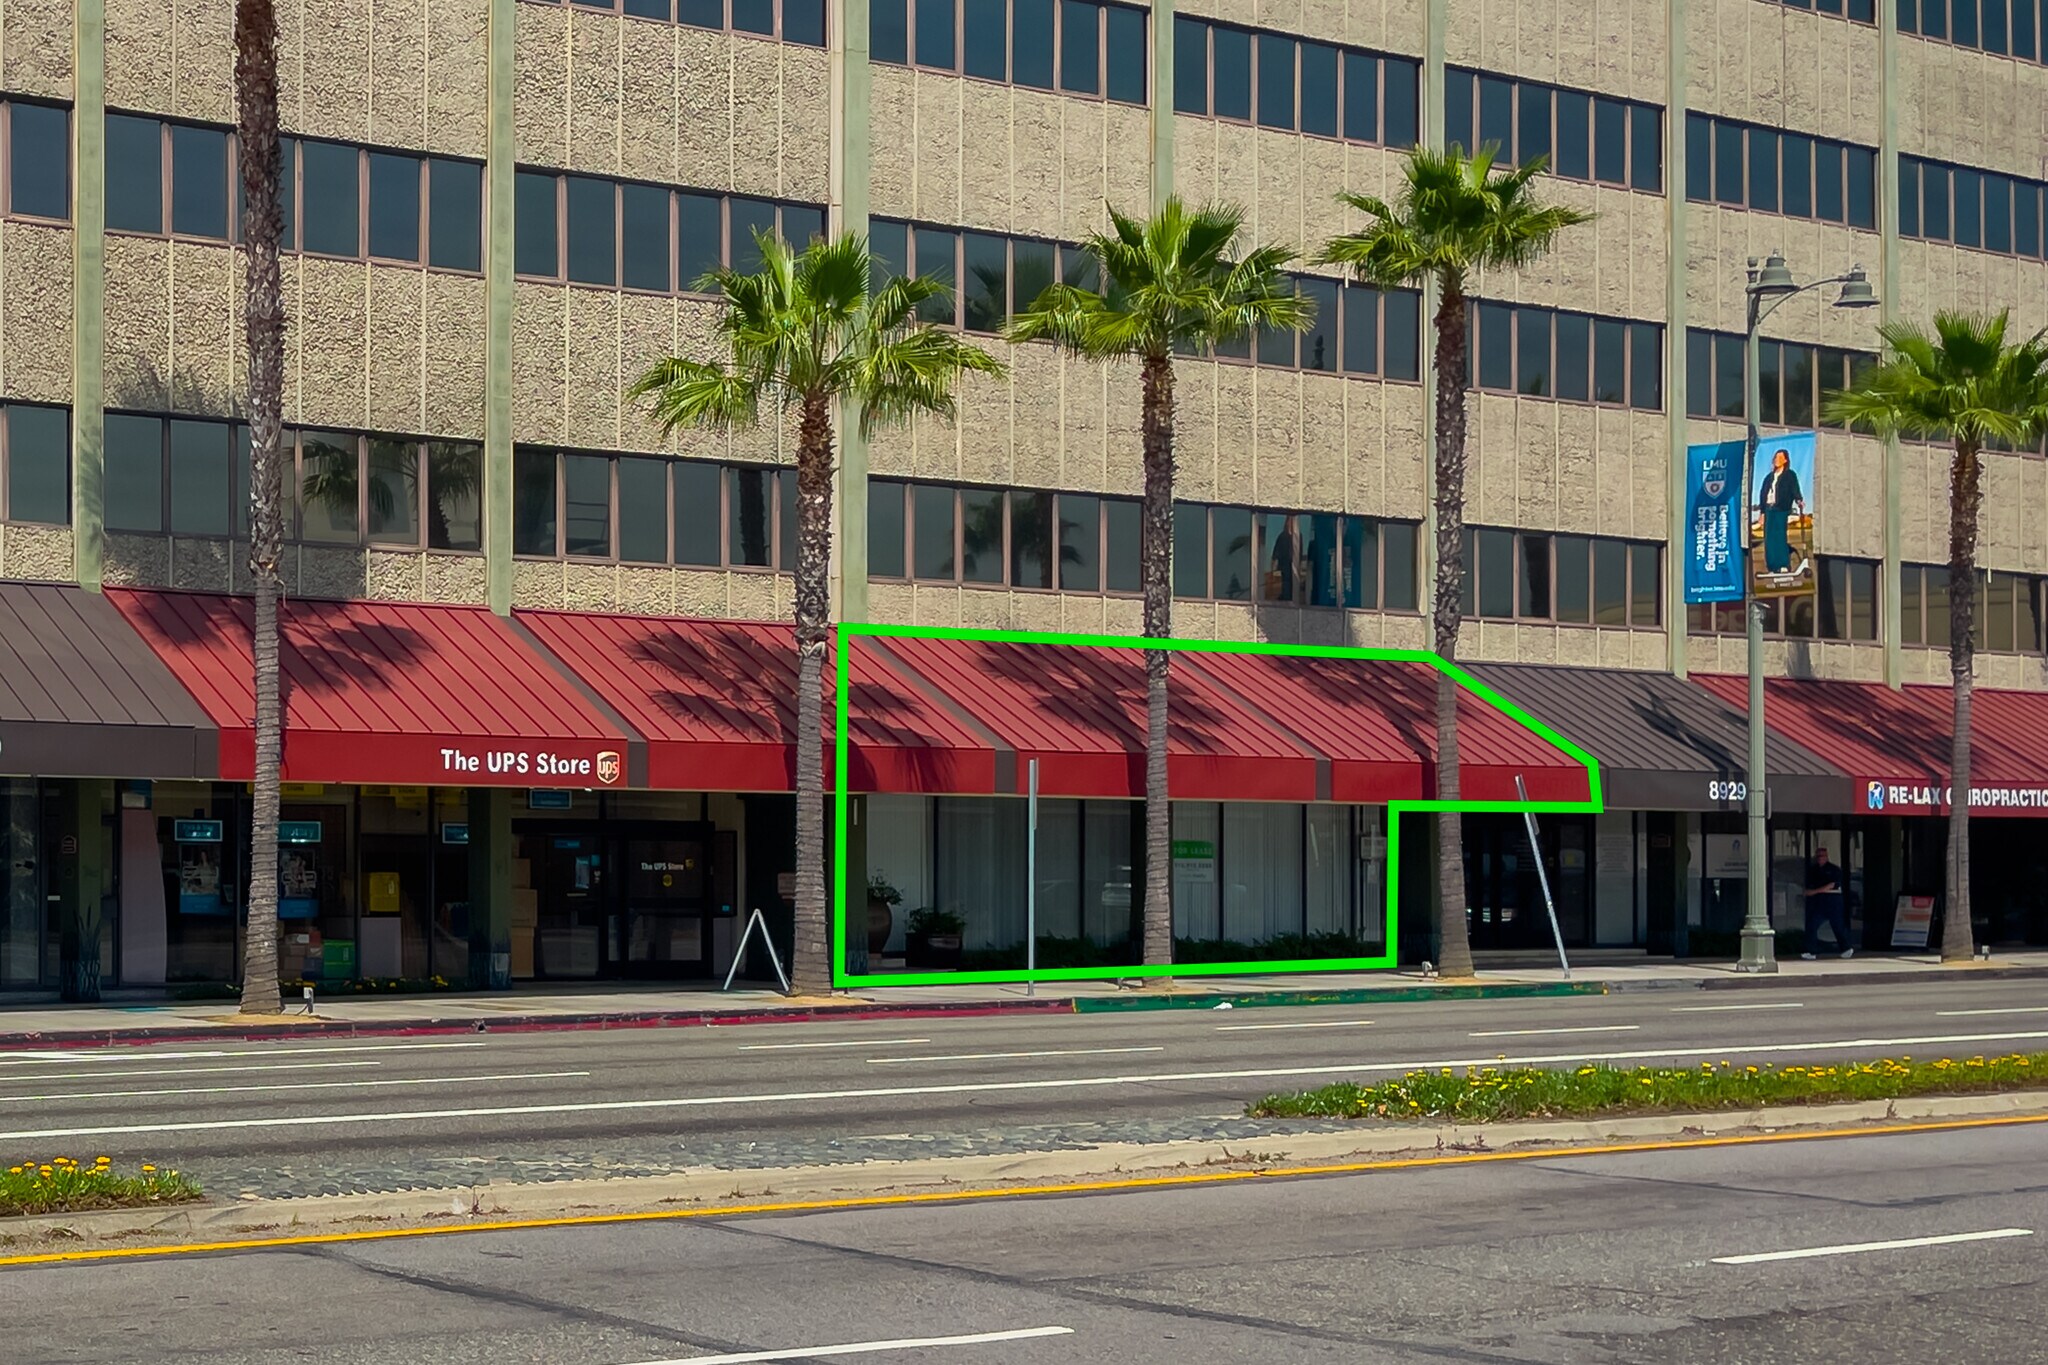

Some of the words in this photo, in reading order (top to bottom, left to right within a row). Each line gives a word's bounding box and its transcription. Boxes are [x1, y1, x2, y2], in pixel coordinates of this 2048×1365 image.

[1703, 459, 1727, 470] LMU
[1695, 506, 1709, 560] brighter.
[1705, 505, 1719, 571] something
[1718, 504, 1729, 549] Believe
[1718, 550, 1729, 564] in
[440, 748, 480, 772] The
[487, 751, 530, 774] UPS
[536, 752, 592, 775] Store
[1709, 780, 1747, 800] 8929
[1888, 785, 1942, 805] RE-LAX
[1945, 787, 2048, 807] CIROPRACTIC
